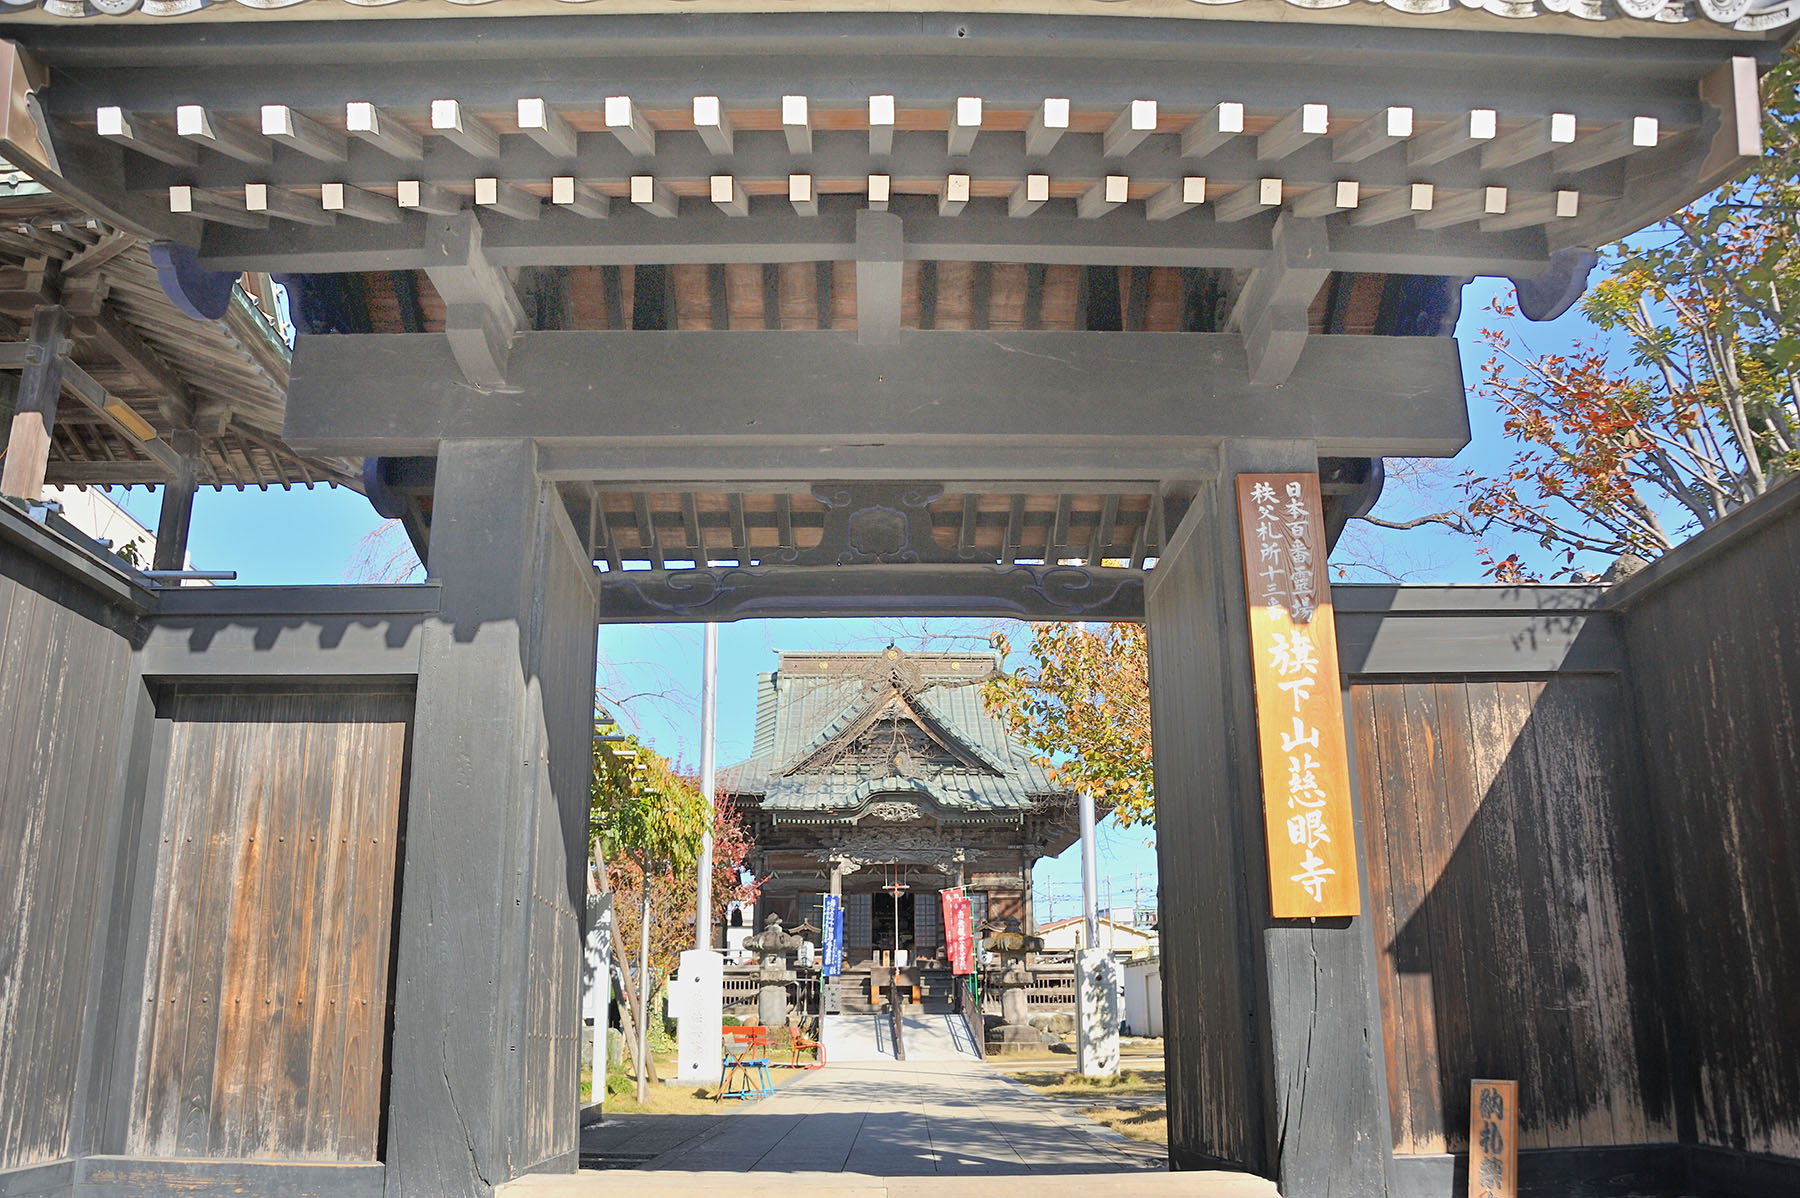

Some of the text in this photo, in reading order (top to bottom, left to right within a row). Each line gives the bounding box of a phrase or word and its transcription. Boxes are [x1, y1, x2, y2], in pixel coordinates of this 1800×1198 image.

[1250, 482, 1287, 621] 秩父札所十三番
[1267, 629, 1336, 903] 旗下山慈眼寺
